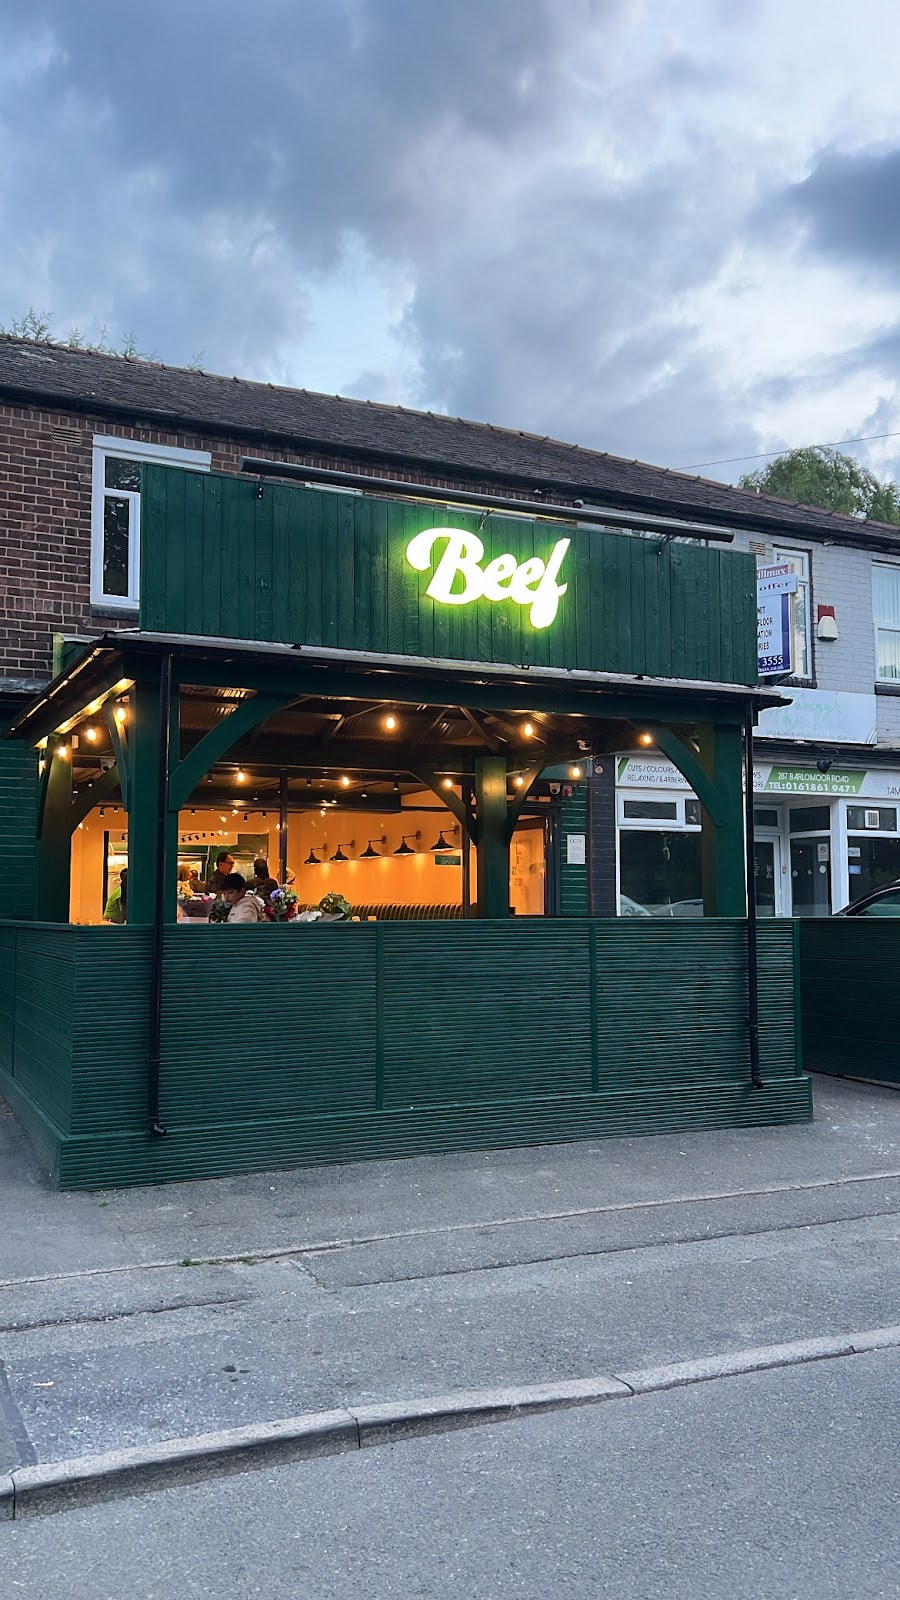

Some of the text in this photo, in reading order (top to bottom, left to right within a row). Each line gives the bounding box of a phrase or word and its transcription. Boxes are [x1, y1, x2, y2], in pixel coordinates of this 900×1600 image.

[406, 527, 571, 629] Beef
[757, 568, 786, 579] illmax
[760, 581, 791, 591] offer
[762, 655, 783, 667] 3555
[831, 774, 849, 783] ROAD
[832, 784, 856, 793] 9471
